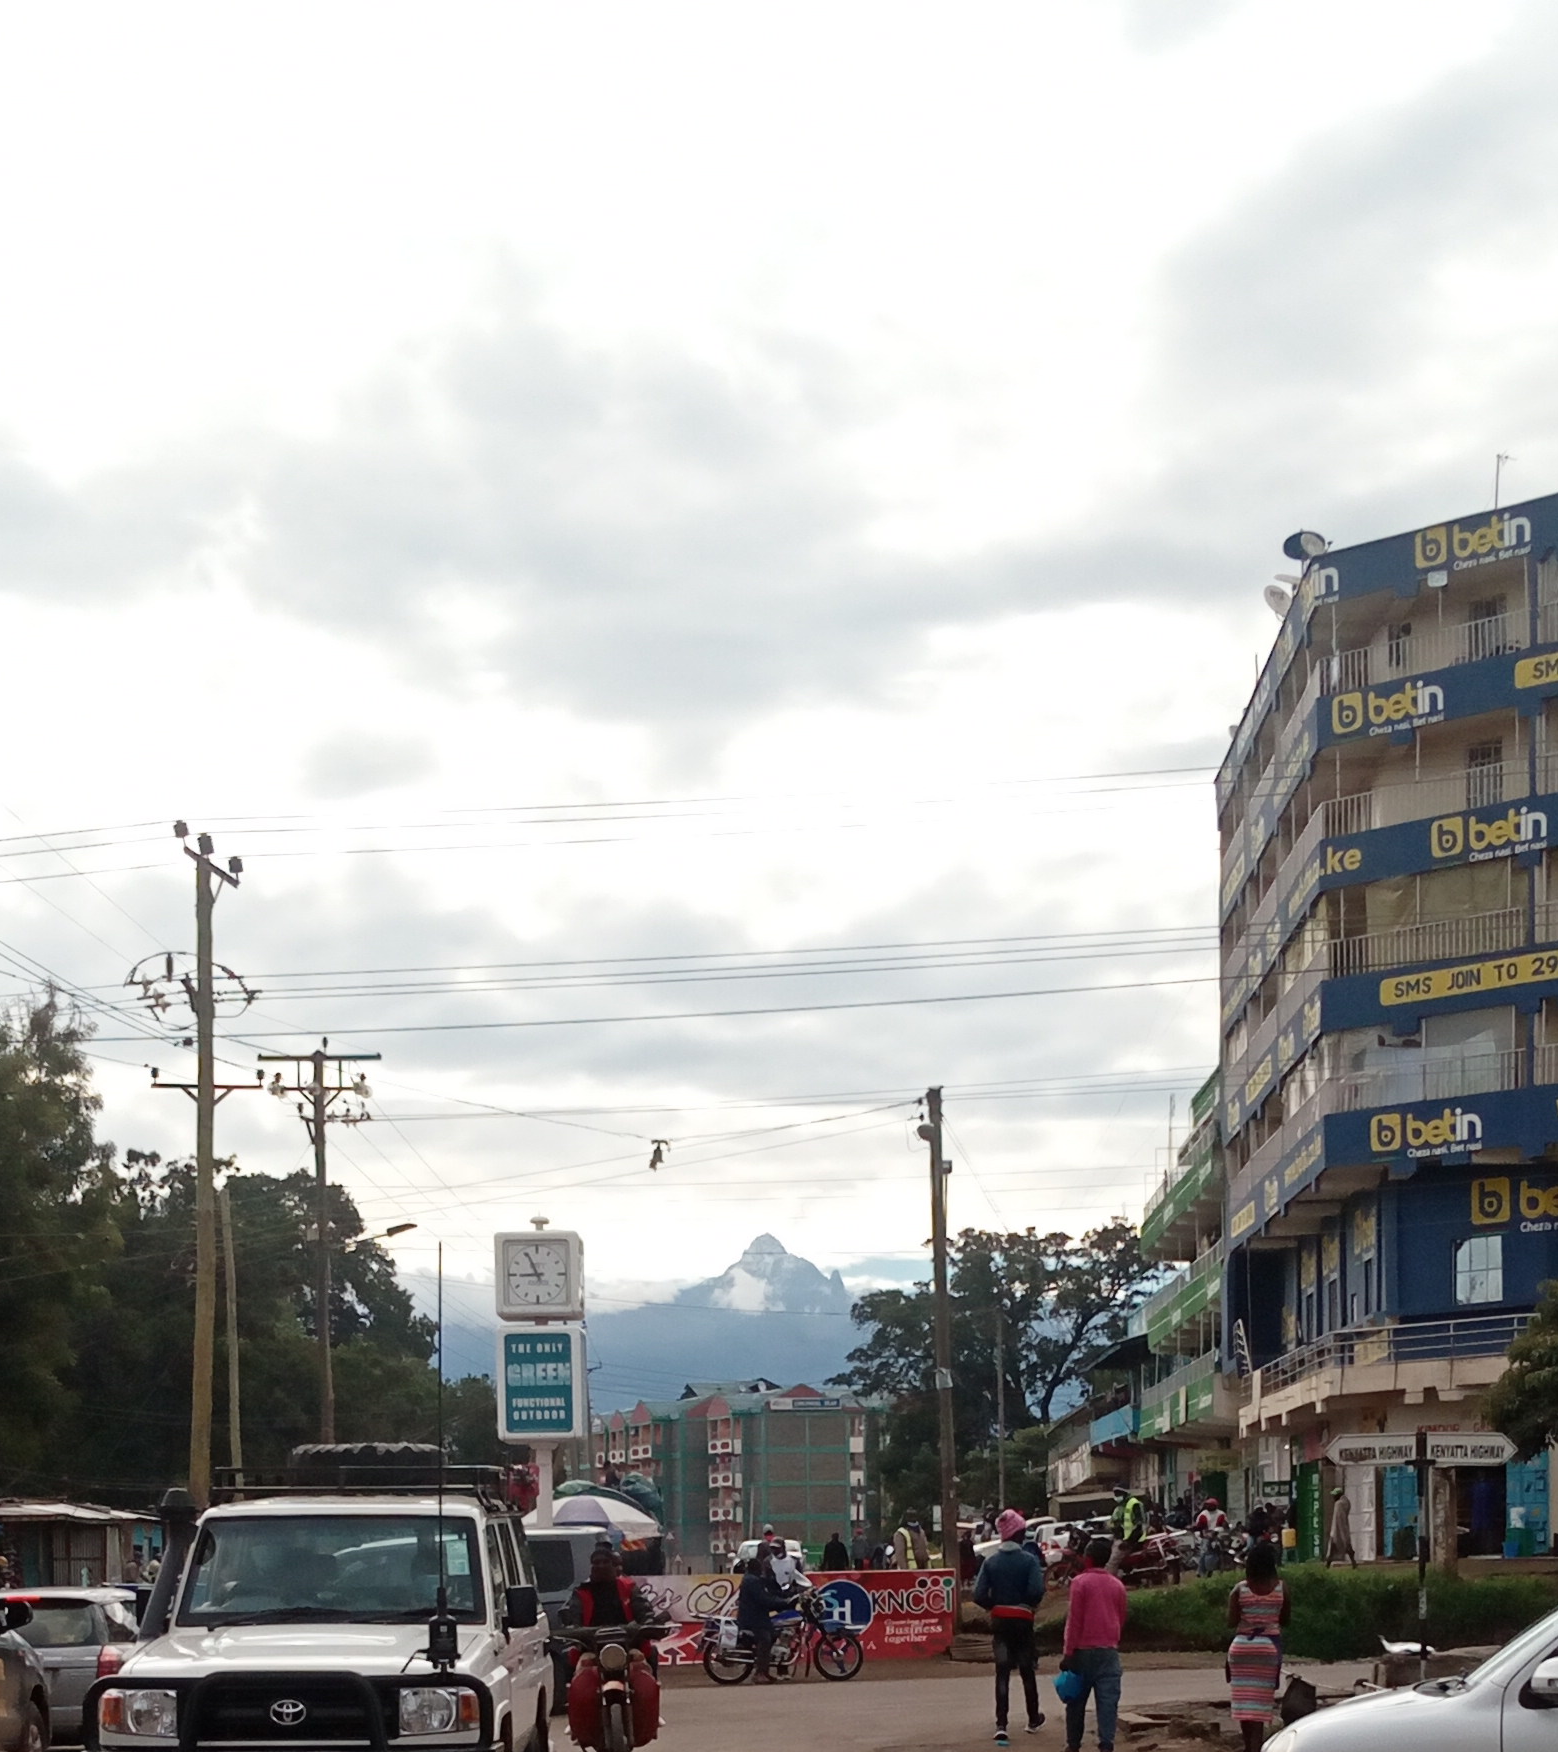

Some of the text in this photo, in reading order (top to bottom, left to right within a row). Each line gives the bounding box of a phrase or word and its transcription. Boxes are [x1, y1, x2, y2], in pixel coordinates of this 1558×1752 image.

[1452, 513, 1532, 557] betin
[1369, 681, 1443, 724] betin
[1469, 807, 1547, 847] betin
[1394, 977, 1431, 998] SMS
[1447, 967, 1481, 990] JOIN
[1497, 962, 1517, 981] TO
[1407, 1107, 1482, 1146] betin
[511, 1343, 563, 1353] THE ONLY
[507, 1363, 571, 1387] GREEN
[512, 1397, 566, 1408] FUNCTIONAL
[513, 1410, 566, 1421] OUTDOOR
[1379, 1445, 1412, 1458] HIGHWAY
[1430, 1445, 1505, 1459] KENYATTA HIGHWAY
[870, 1588, 954, 1616] KNCCI
[884, 1632, 928, 1644] together
[885, 1624, 942, 1636] Business
